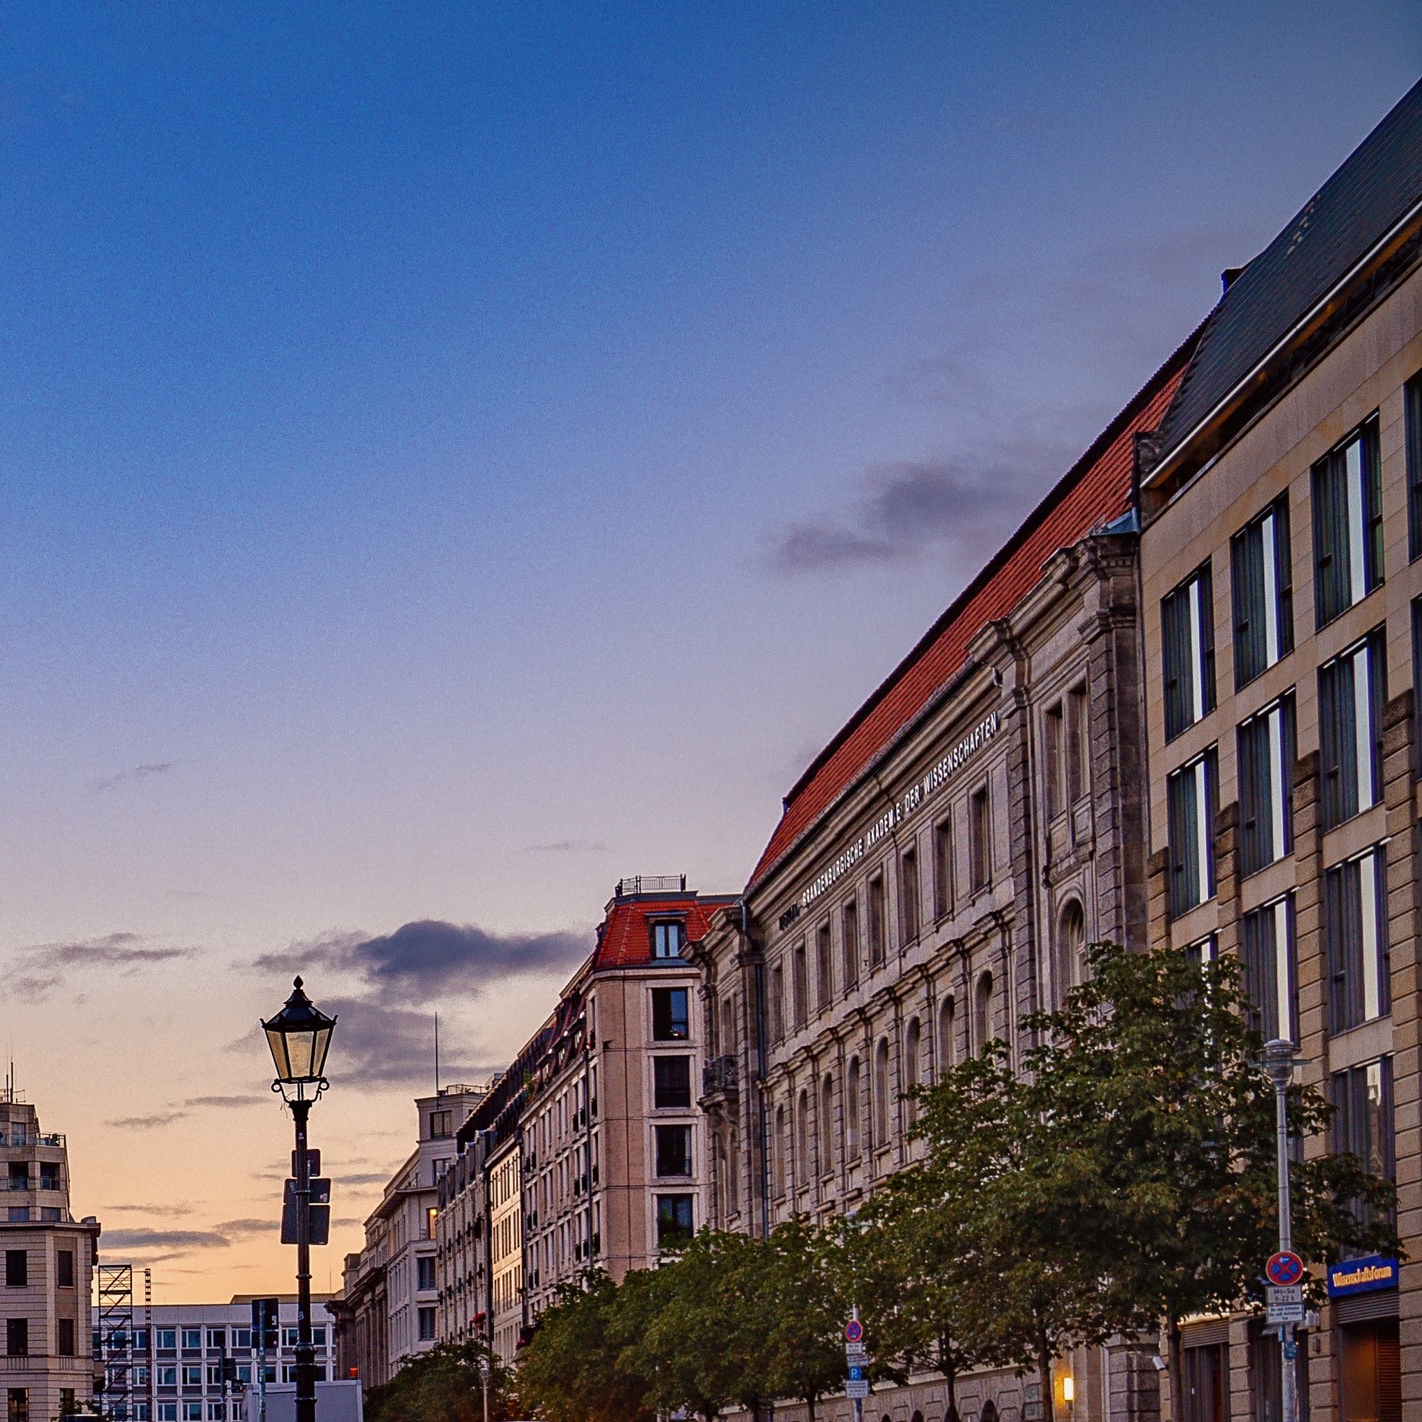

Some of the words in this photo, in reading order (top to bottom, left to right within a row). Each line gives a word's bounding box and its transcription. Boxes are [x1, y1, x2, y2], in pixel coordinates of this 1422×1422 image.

[867, 802, 901, 850] AKADEMIE
[904, 784, 921, 812] DER
[923, 711, 999, 795] WISSENSCHAFTEN
